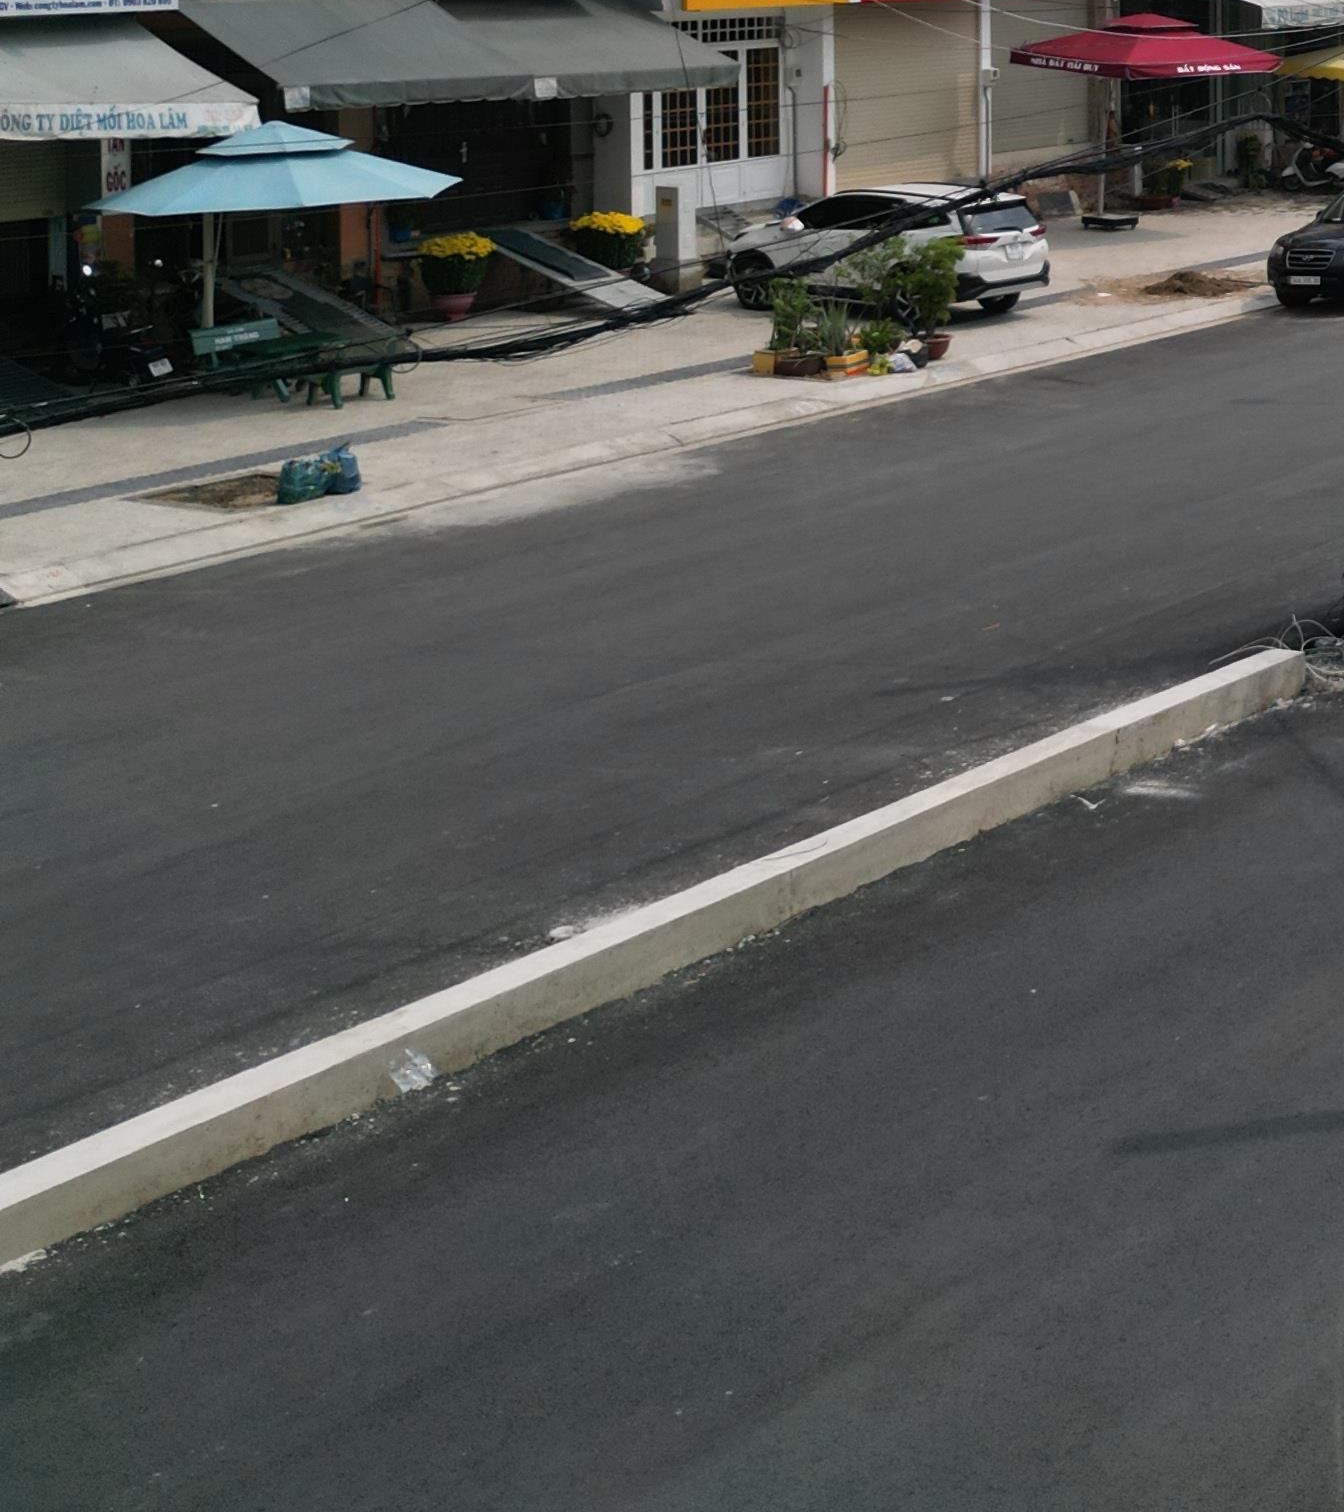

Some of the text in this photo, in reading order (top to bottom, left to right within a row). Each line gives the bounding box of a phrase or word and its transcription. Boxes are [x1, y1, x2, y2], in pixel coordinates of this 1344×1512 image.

[35, 113, 58, 131] TY
[59, 108, 93, 136] DIỆT
[127, 111, 156, 130] HOA
[159, 107, 188, 129] LÂM
[106, 164, 127, 192] GỐC
